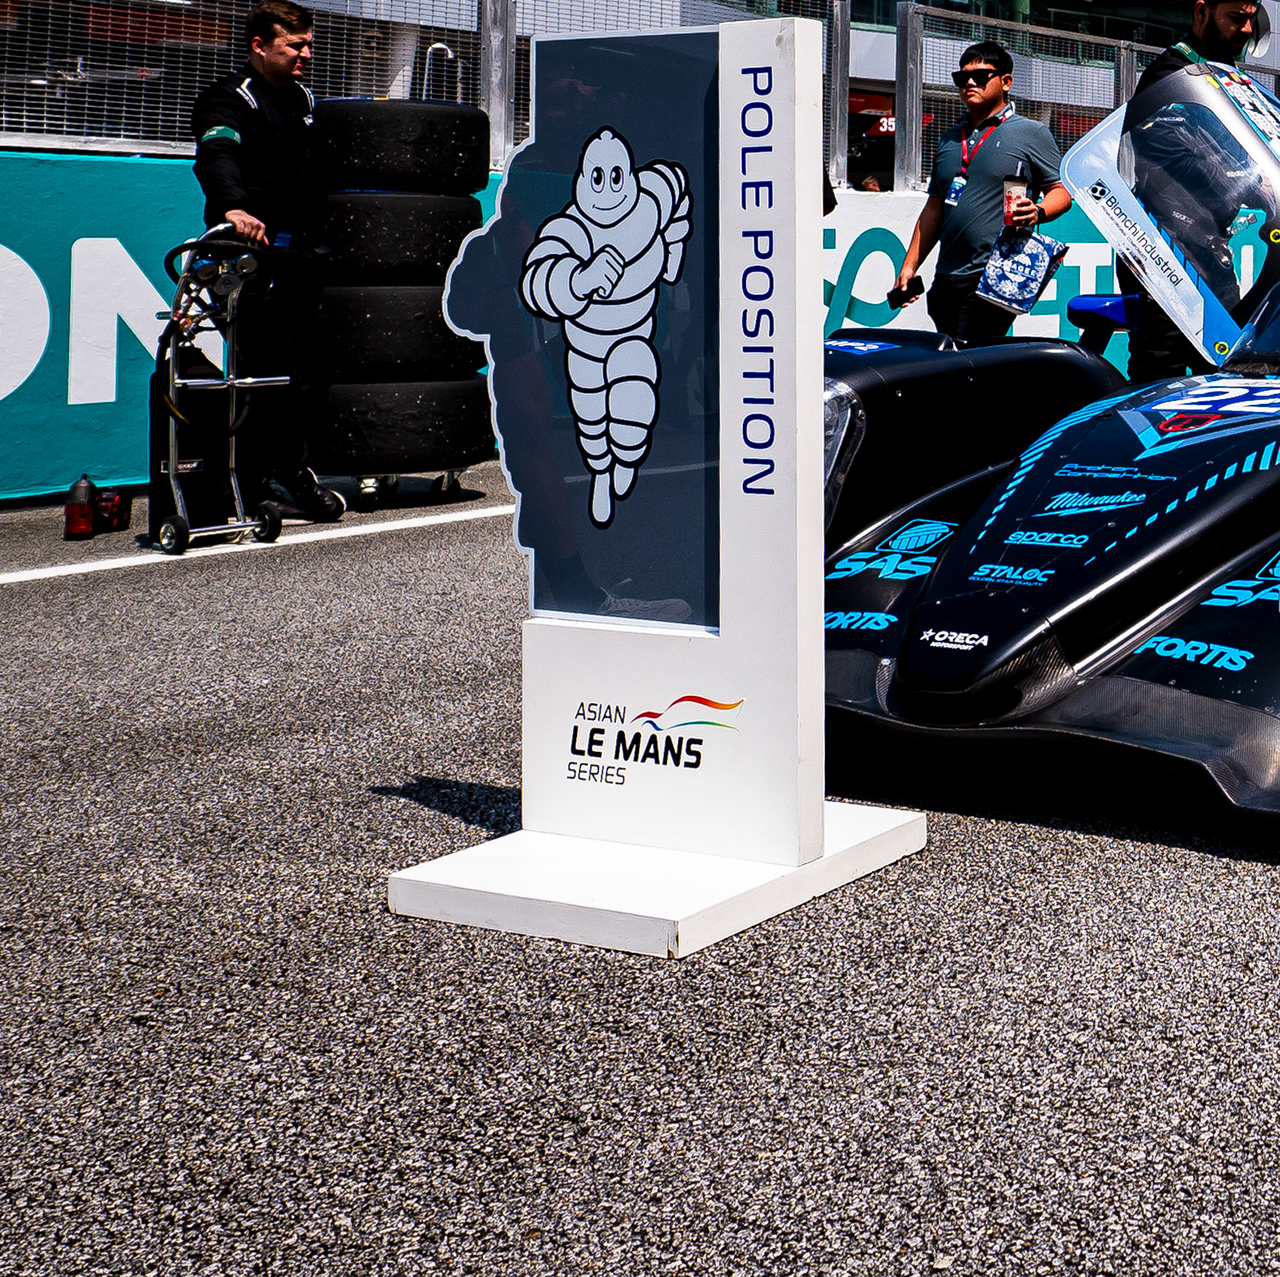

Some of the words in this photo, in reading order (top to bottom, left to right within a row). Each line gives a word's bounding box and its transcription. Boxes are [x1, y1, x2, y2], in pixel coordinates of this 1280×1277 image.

[879, 117, 896, 132] 35
[740, 66, 773, 210] POLE
[1105, 195, 1141, 237] Bianchi
[1135, 228, 1184, 287] Industrial
[740, 229, 776, 495] POSITION
[1044, 491, 1147, 512] Milwaukee
[1007, 530, 1089, 545] sparco
[825, 551, 938, 580] SAS
[973, 564, 1056, 582] STALOC
[935, 631, 989, 647] ORECA
[1133, 635, 1256, 672] FORTIS
[575, 702, 627, 725] ASIAN
[570, 725, 606, 758] LE
[614, 729, 704, 769] MANS
[567, 761, 627, 786] SERIES
